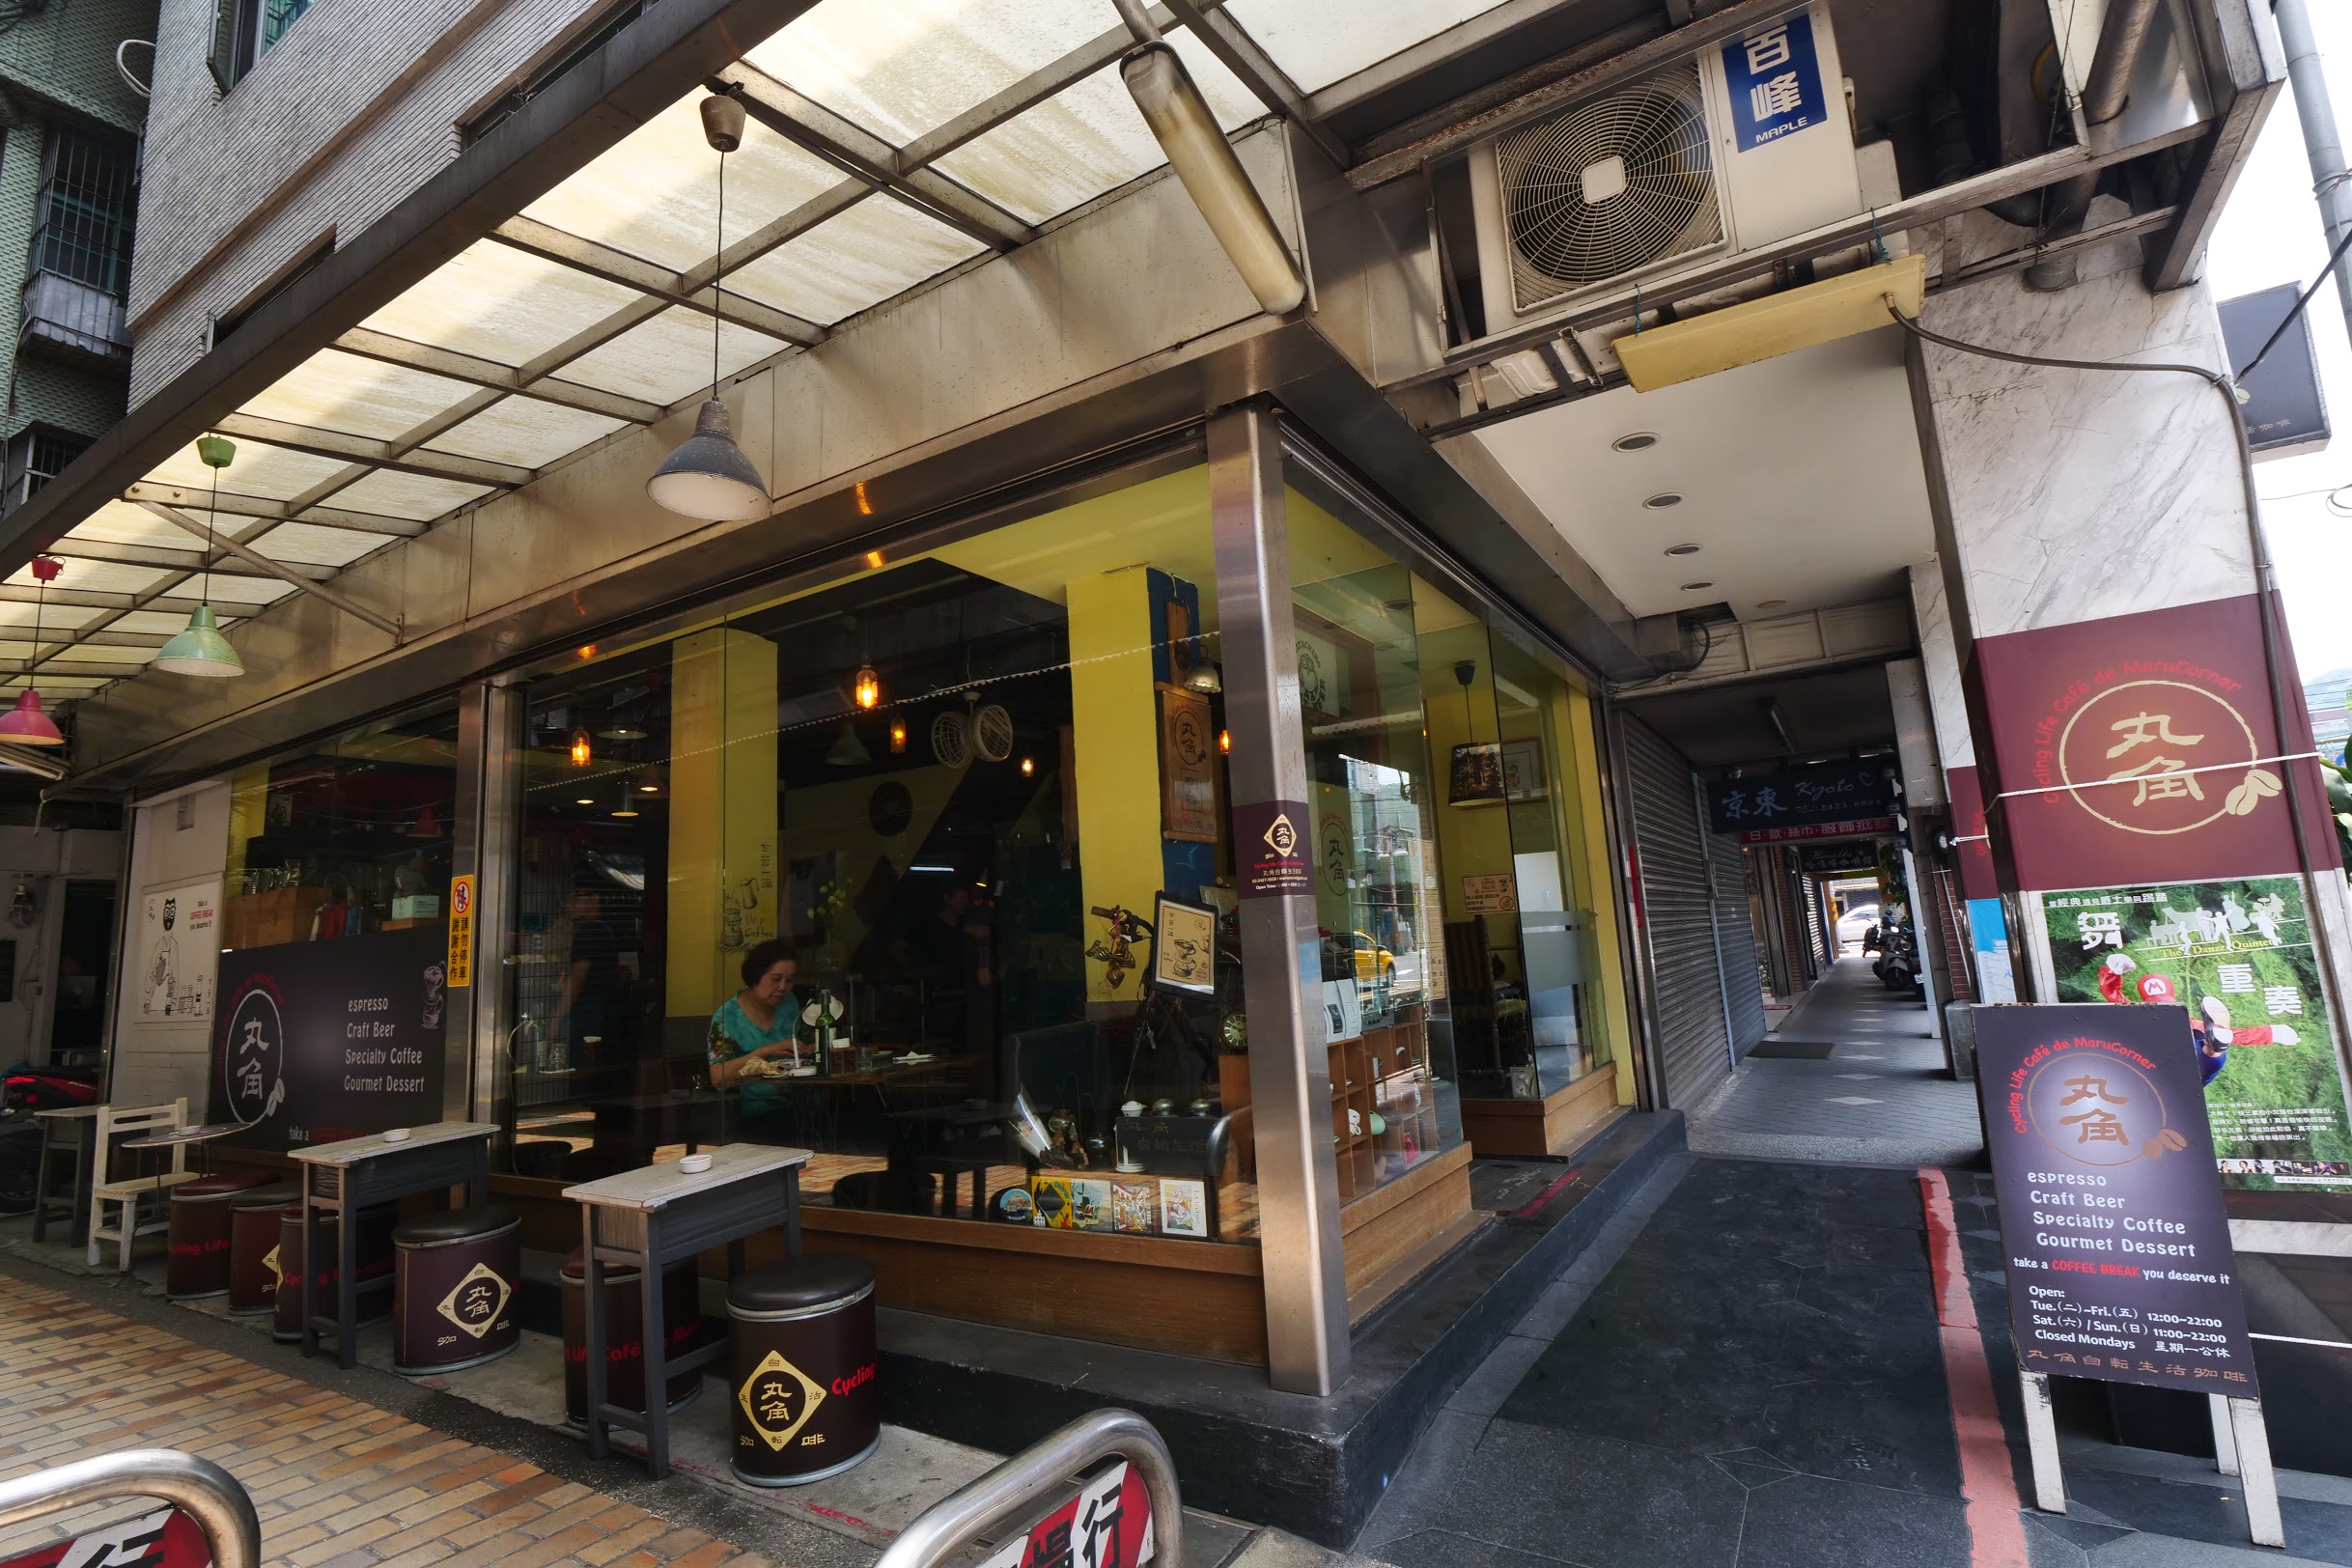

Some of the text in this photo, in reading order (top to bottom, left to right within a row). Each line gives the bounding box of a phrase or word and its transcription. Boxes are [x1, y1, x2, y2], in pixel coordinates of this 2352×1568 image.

[1744, 25, 1803, 123] 百峰
[1755, 116, 1808, 144] MAPLE
[2035, 715, 2058, 744] Life
[2055, 680, 2090, 713] Café
[2093, 668, 2116, 686] de
[2122, 660, 2242, 692] MaruCorner
[2106, 711, 2206, 807] 丸角
[1794, 778, 1855, 801] Kyoto
[450, 917, 461, 982] 謝謝合作
[459, 916, 469, 981] 請勿停車
[2159, 948, 2182, 959] The
[348, 997, 389, 1013] espresso
[347, 1021, 396, 1038] Craft Beer
[237, 1017, 270, 1101] 丸角
[345, 1047, 423, 1065] Specialty Coffee
[344, 1075, 425, 1092] Gourmet Dessert
[2007, 1036, 2157, 1134] Cycling Life Café de MaruCorner
[2058, 1074, 2132, 1146] 丸角
[2028, 1171, 2108, 1187] espresso
[2030, 1190, 2126, 1209] Craft Beer
[2032, 1211, 2186, 1235] Specialty Coffee
[2036, 1232, 2196, 1257] Gourmet Dessert
[2013, 1257, 2230, 1285] take a COFFEE BREAK you deserve it
[464, 1286, 492, 1318] 丸角
[2029, 1285, 2065, 1299] Open:
[496, 1319, 511, 1330] 啡
[2146, 1313, 2223, 1329] 12:00~22:00
[437, 1335, 457, 1347] 咖
[2034, 1330, 2231, 1358] Closed Mondays 星期一公休
[2152, 1328, 2227, 1344] 11:00~22:00
[768, 1358, 780, 1367] 自
[831, 1361, 877, 1397] Cycling
[760, 1381, 793, 1422] 丸角
[809, 1390, 822, 1401] 活
[739, 1435, 754, 1447] 咖
[771, 1436, 783, 1444] 転
[801, 1434, 826, 1446] 啡
